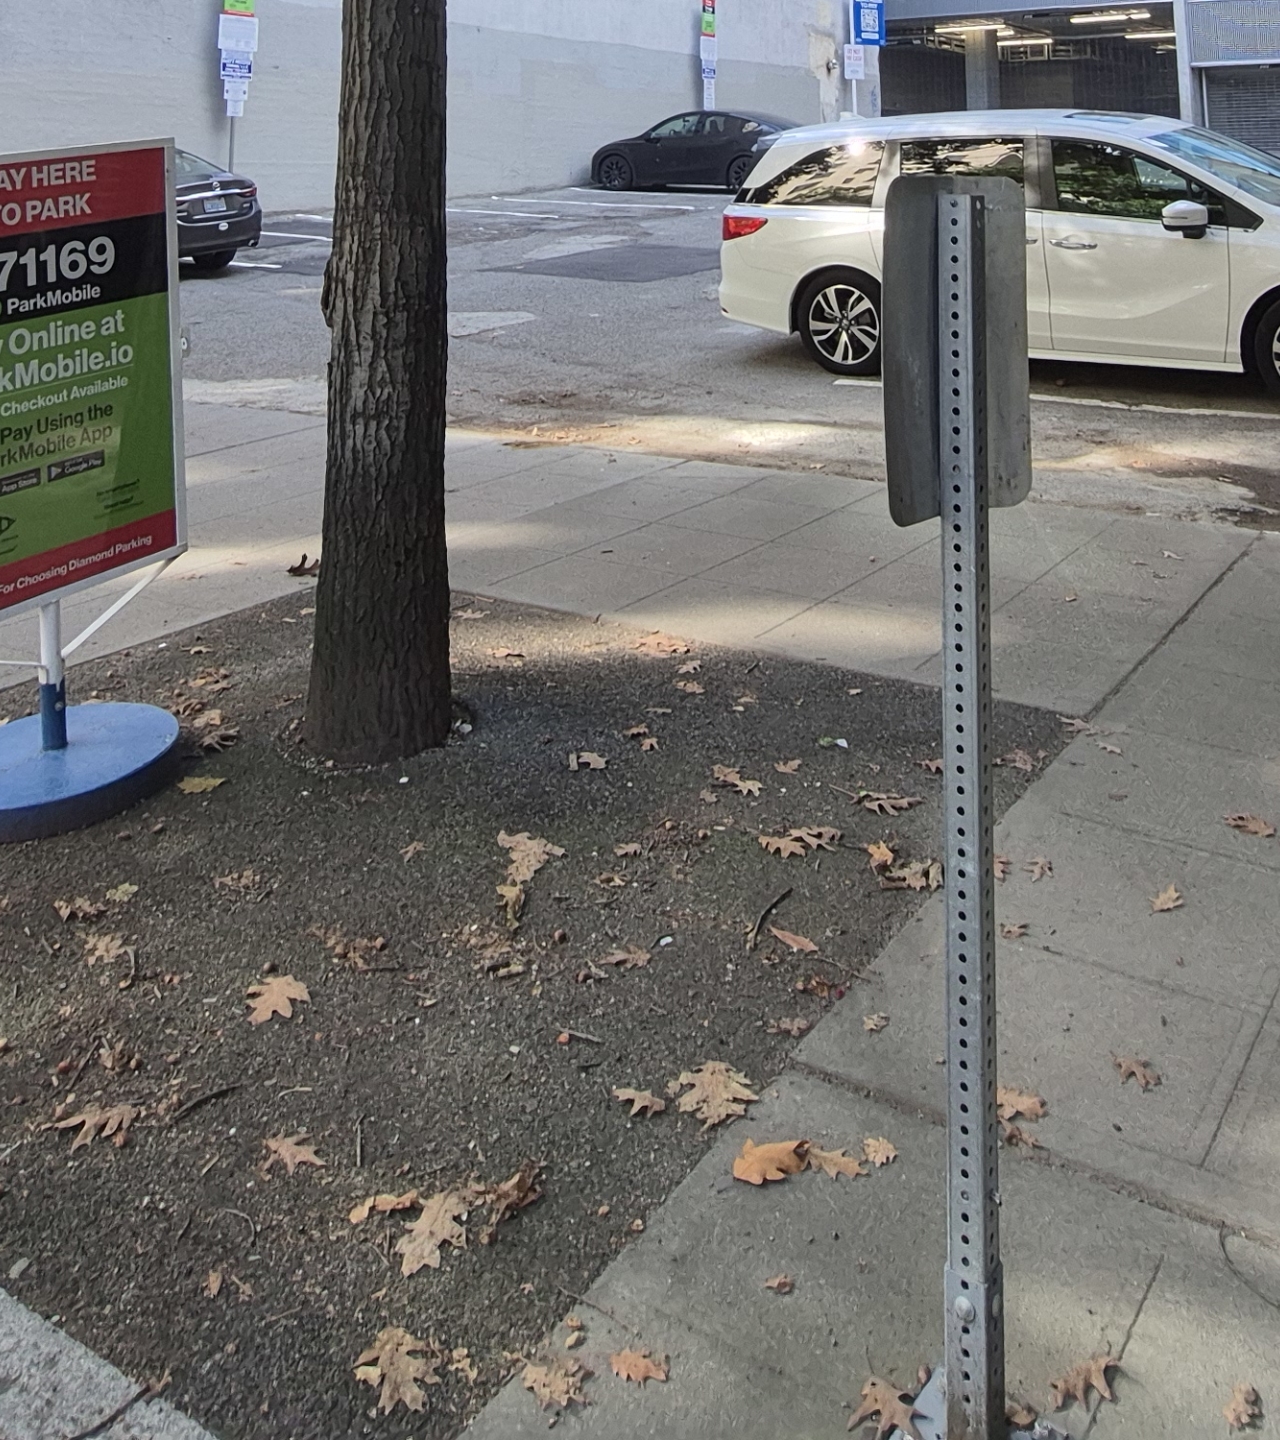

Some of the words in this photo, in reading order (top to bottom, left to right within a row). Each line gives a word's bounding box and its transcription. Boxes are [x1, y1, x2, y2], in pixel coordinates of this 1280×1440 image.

[31, 160, 97, 188] HERE
[26, 193, 92, 223] PARK
[7, 283, 101, 315] ParkMobile
[8, 320, 96, 355] Online
[100, 309, 125, 334] at
[0, 392, 68, 418] Checkout
[70, 375, 129, 401] Available
[0, 424, 33, 446] Pay
[36, 412, 85, 436] Using
[88, 403, 114, 421] the
[80, 423, 113, 449] App
[16, 564, 67, 589] Choosing
[68, 548, 115, 570] Diamond
[115, 534, 152, 556] Parking
